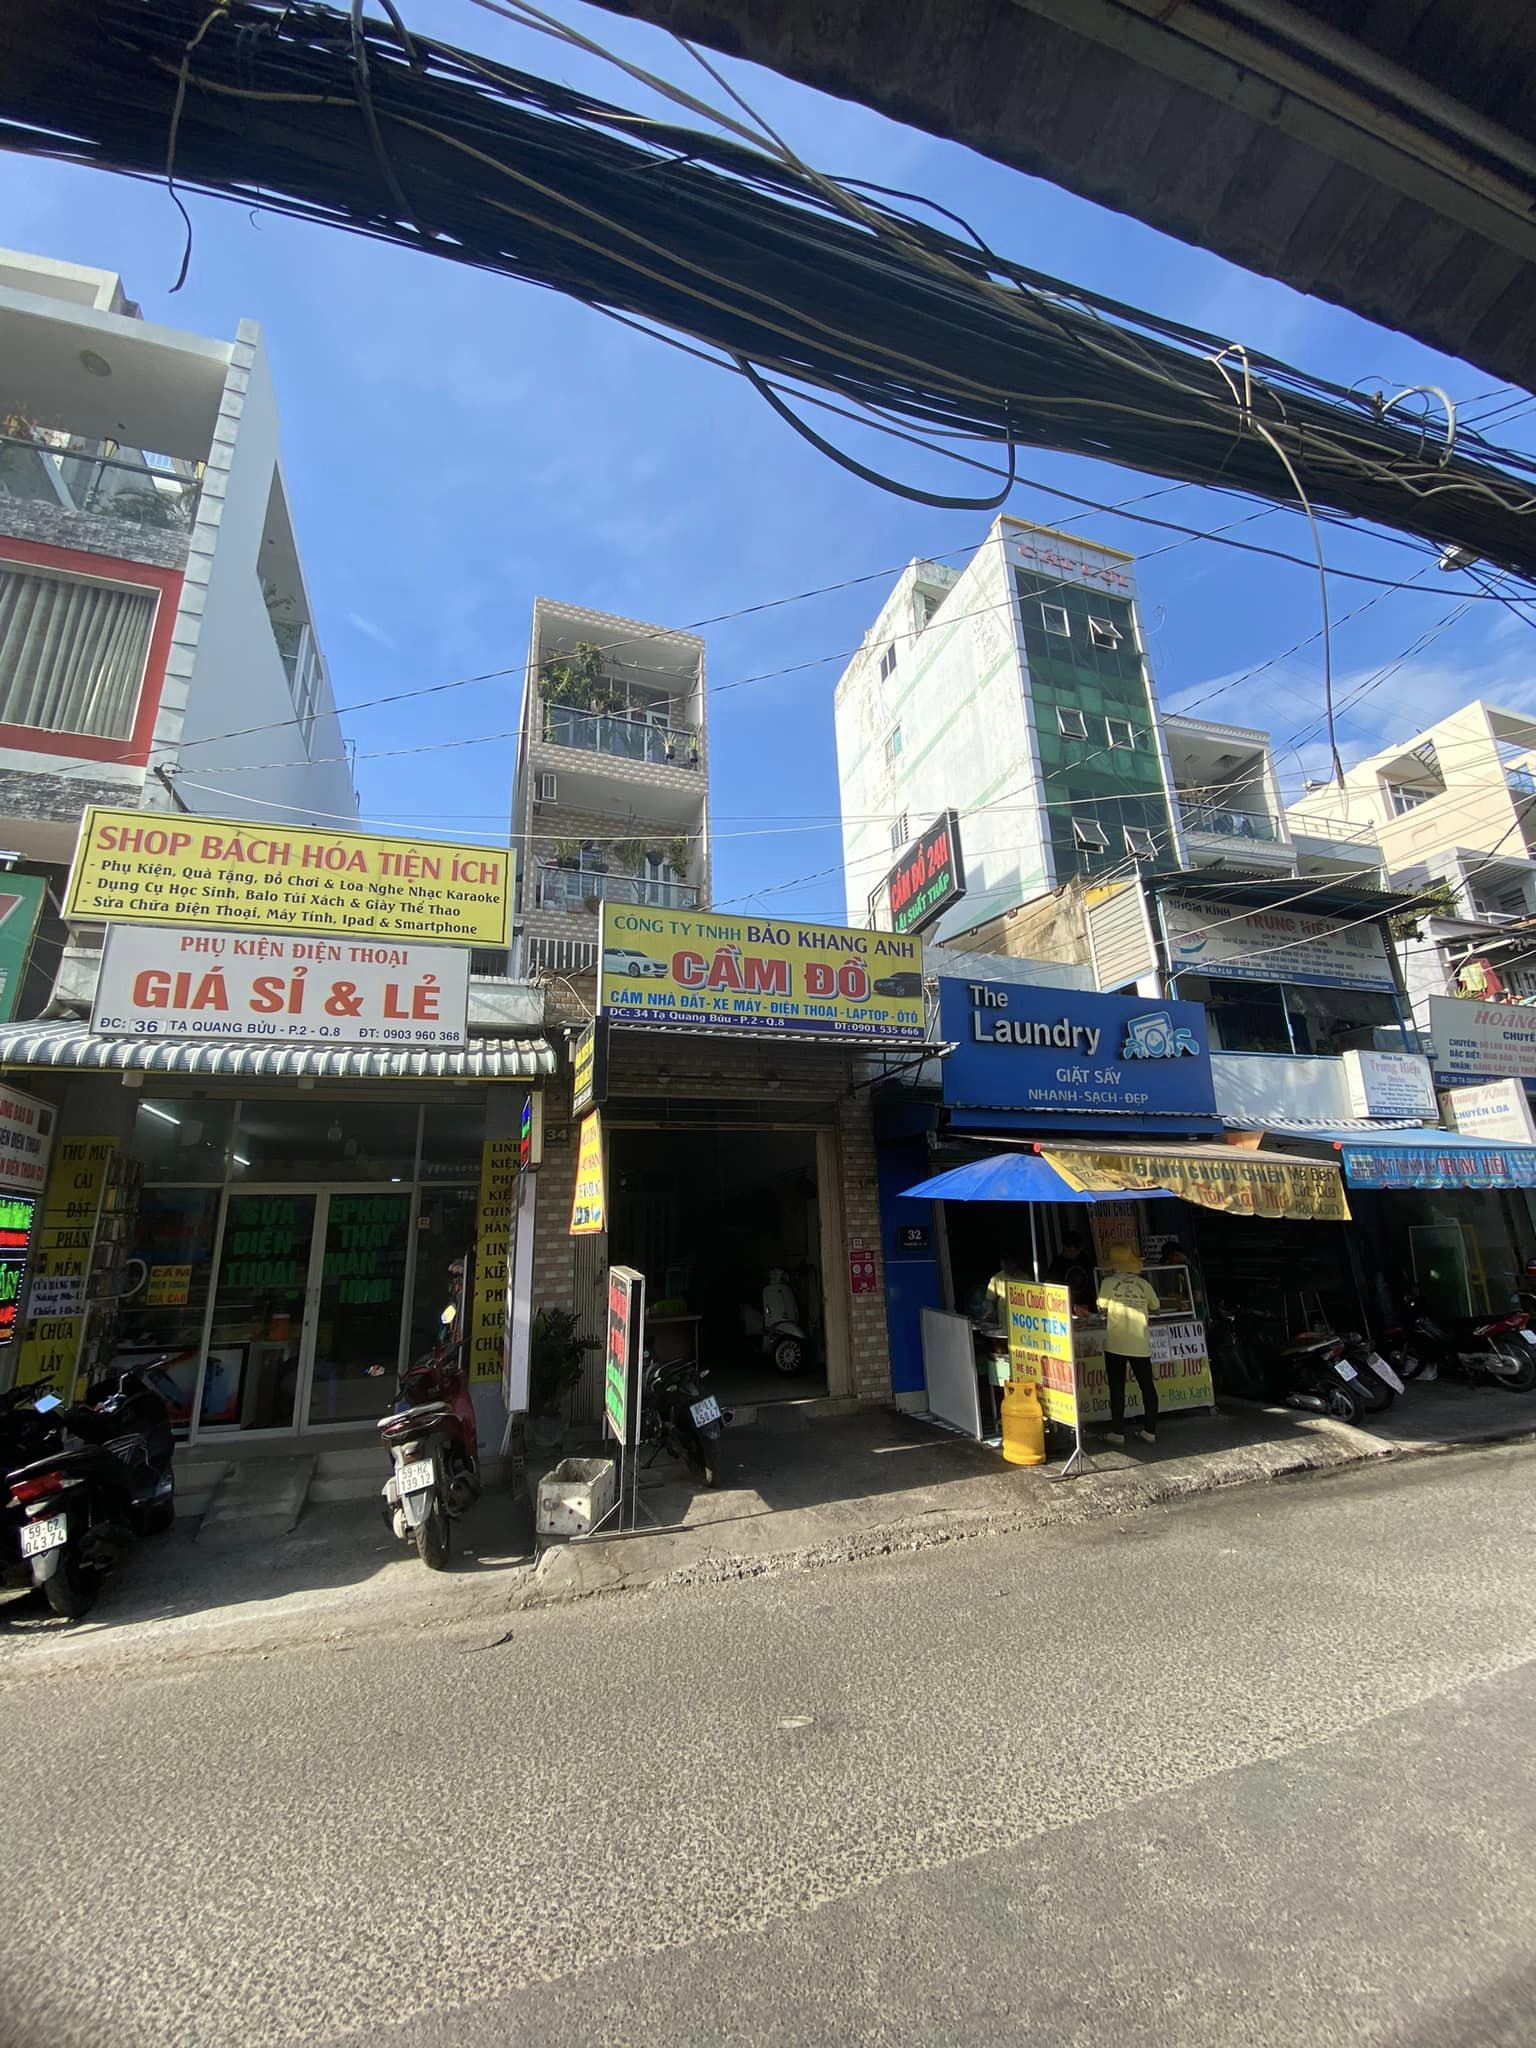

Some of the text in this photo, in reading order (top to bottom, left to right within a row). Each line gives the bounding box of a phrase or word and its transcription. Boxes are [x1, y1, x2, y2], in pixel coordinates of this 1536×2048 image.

[96, 825, 498, 886] SHOP BÁCH HÓA TIỆN ÍCH
[101, 860, 500, 904] Phụ Kiện, Quà Tặng, Đồ Chơi & Loa Nghe Nhạc Karaoke
[891, 868, 912, 913] CẦM
[927, 870, 950, 904] THẤP
[97, 878, 460, 917] Dụng Cụ Học Sinh, Balo Túi Xách & Giày Thể Thao
[93, 895, 477, 935] Sửa Chữa Điện Thoại, Máy Tính, Ipad & Smartphone
[1246, 913, 1297, 934] TRUNG
[614, 914, 914, 958] CÔNG TY TNHH BẢO KHANG ANH
[180, 936, 408, 968] PHỤ KIỆN ĐIỆN THOẠI
[672, 943, 869, 1001] CẦM ĐỒ
[132, 966, 441, 1020] GIÁ SỈ & LẺ
[648, 991, 676, 1007] NHÀ
[713, 998, 729, 1010] XE
[733, 997, 762, 1012] MÁY
[770, 1000, 799, 1018] ĐIỆN
[804, 1003, 838, 1019] THOẠI
[846, 1007, 889, 1022] LAPTOP
[897, 1009, 918, 1023] ÔTÔ
[969, 984, 1009, 1008] The
[100, 1017, 460, 1041] ĐC: 36 TẠ QUANG BỬU P.2 Q.8 ĐT: 0903 960 368
[634, 1009, 649, 1018] 34
[653, 1010, 666, 1020] Tạ
[669, 1011, 706, 1024] Quang
[740, 1015, 757, 1024] P.2
[766, 1017, 785, 1027] Q.8
[852, 1023, 876, 1033] 0901
[880, 1025, 898, 1034] 535
[901, 1026, 919, 1035] 666
[972, 1011, 1100, 1055] Laundry
[1056, 1066, 1121, 1087] GIẶT SẤY
[1028, 1088, 1149, 1105] NHANH SẠCH ĐẸP
[545, 1128, 568, 1140] 34
[907, 1229, 922, 1240] 32
[1012, 1311, 1039, 1334] NGỌC
[1168, 1324, 1203, 1339] MUA 10
[1173, 1342, 1198, 1358] TẶNG
[1200, 1342, 1206, 1353] 1
[28, 1518, 60, 1540] 59-G2
